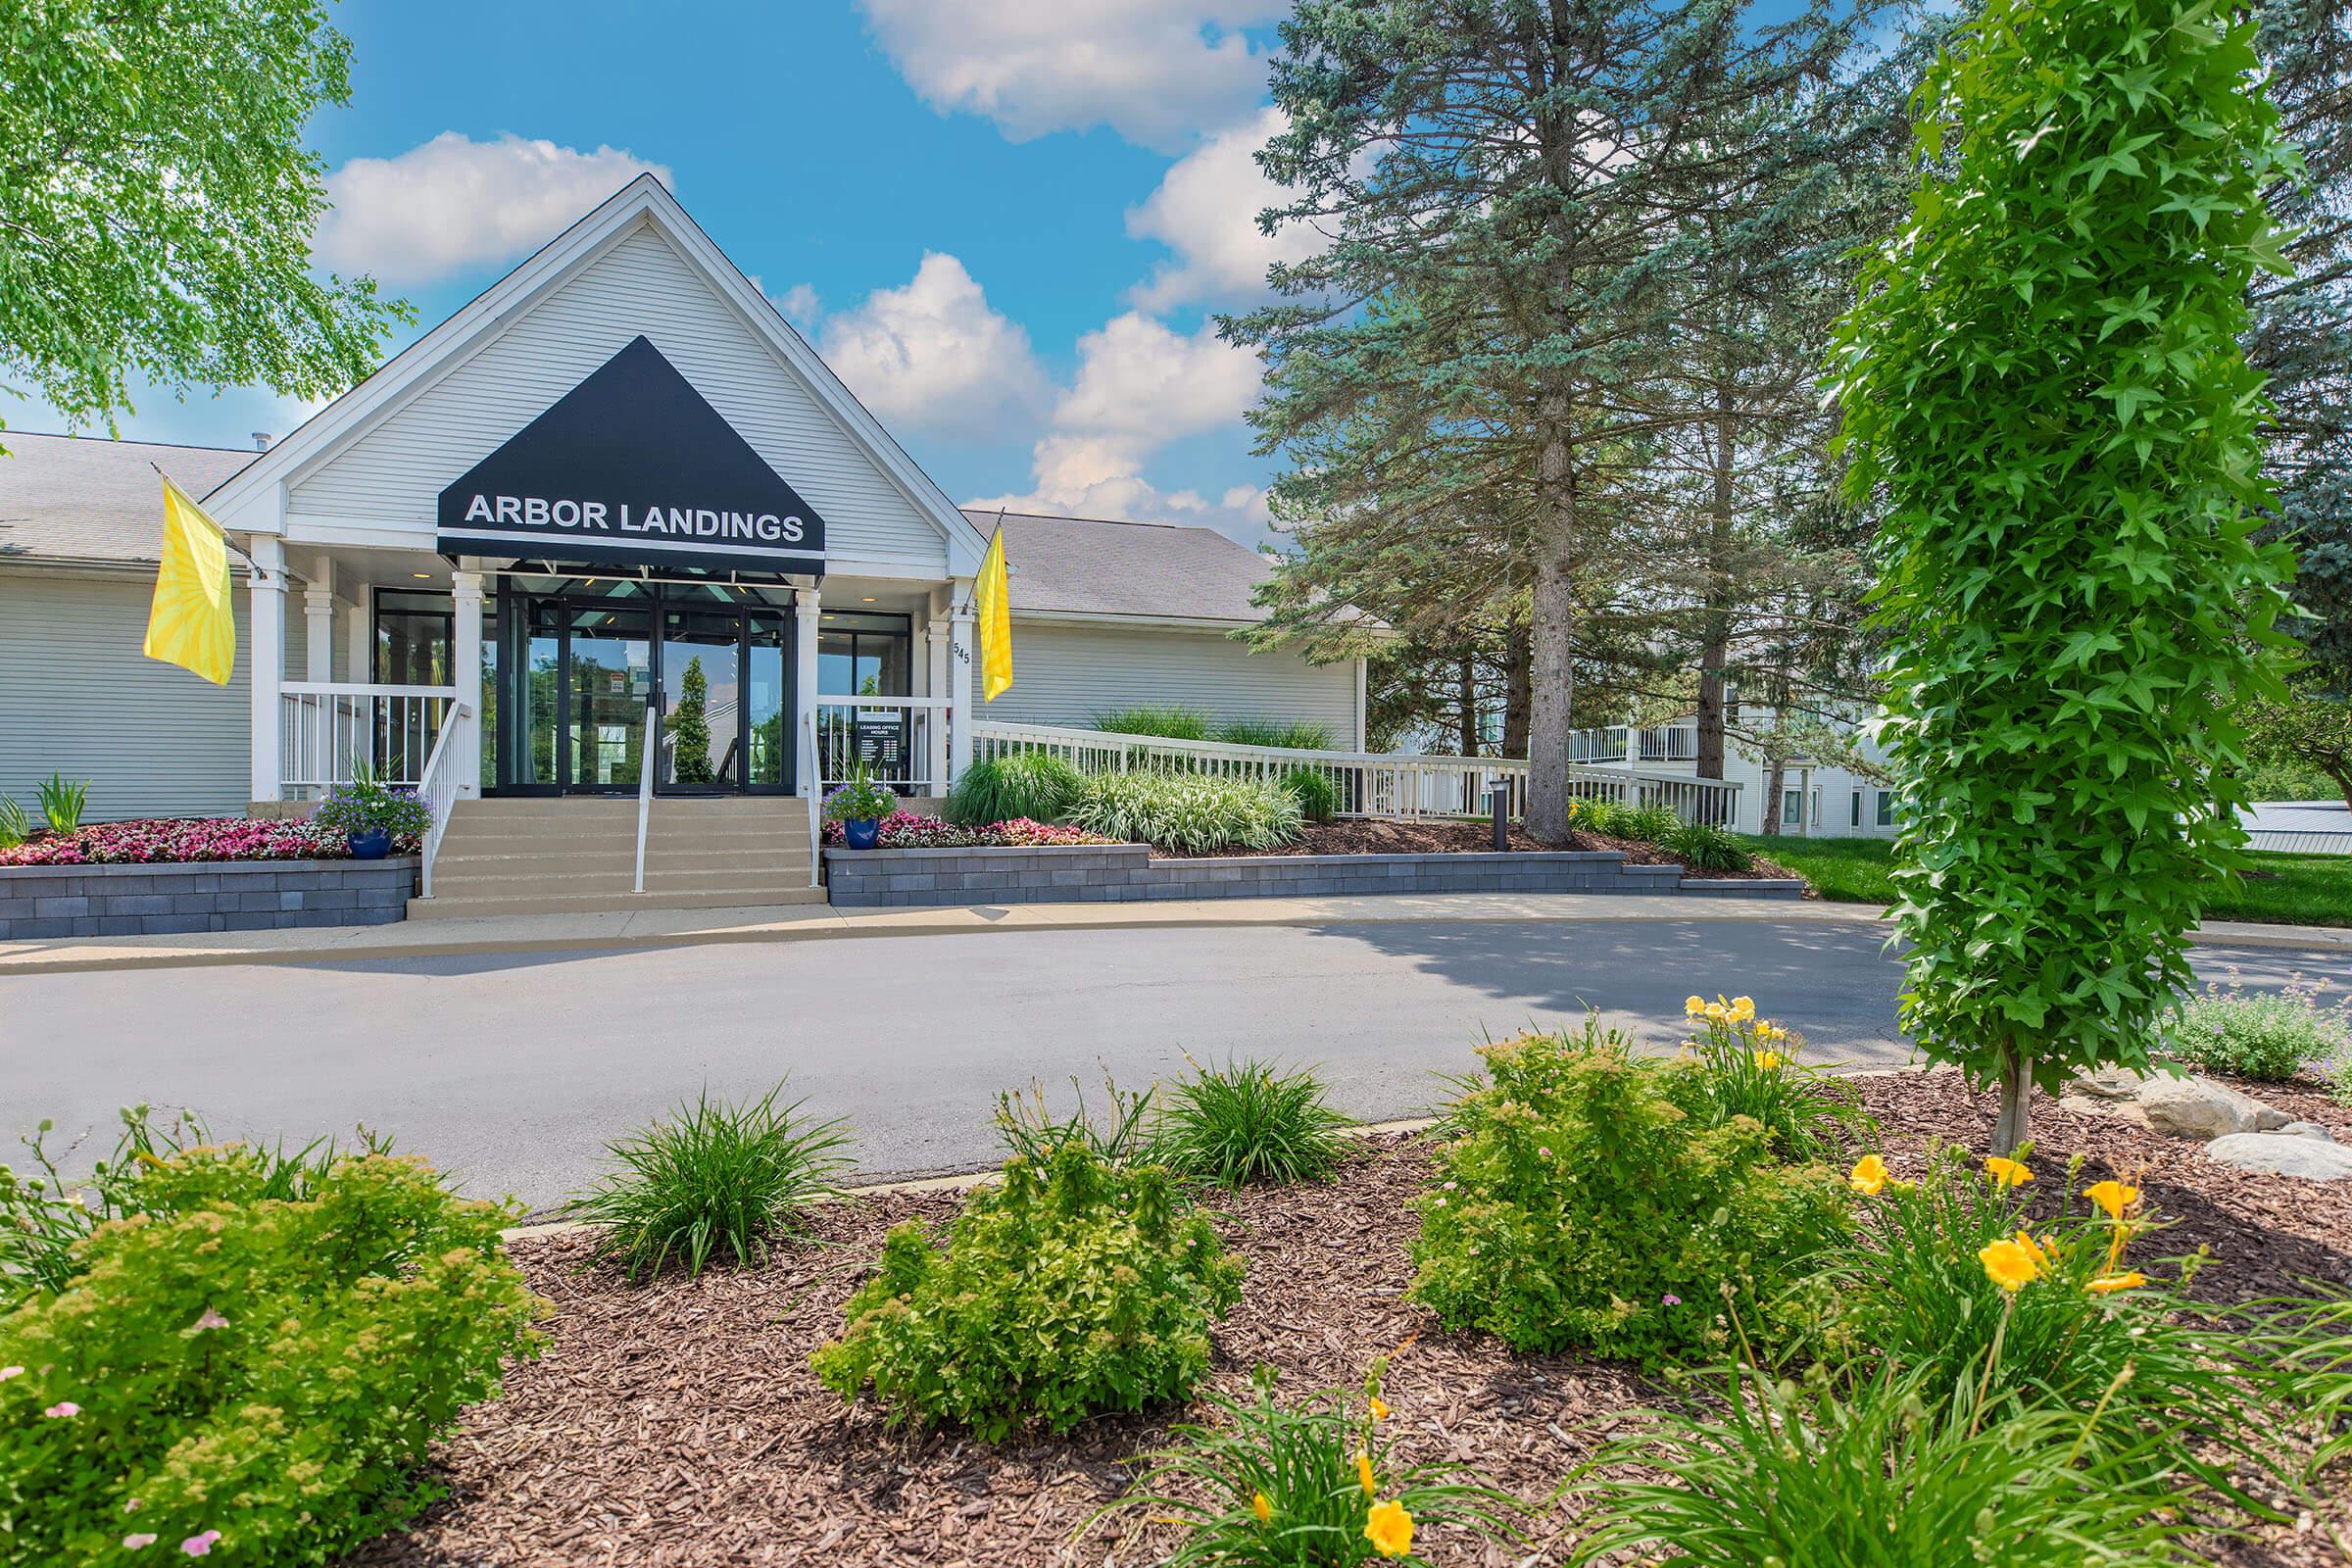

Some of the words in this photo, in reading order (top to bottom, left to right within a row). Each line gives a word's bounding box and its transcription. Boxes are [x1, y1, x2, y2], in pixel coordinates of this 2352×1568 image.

[465, 494, 609, 529] ARBOR
[619, 504, 804, 542] LANDINGS
[954, 642, 970, 664] 545
